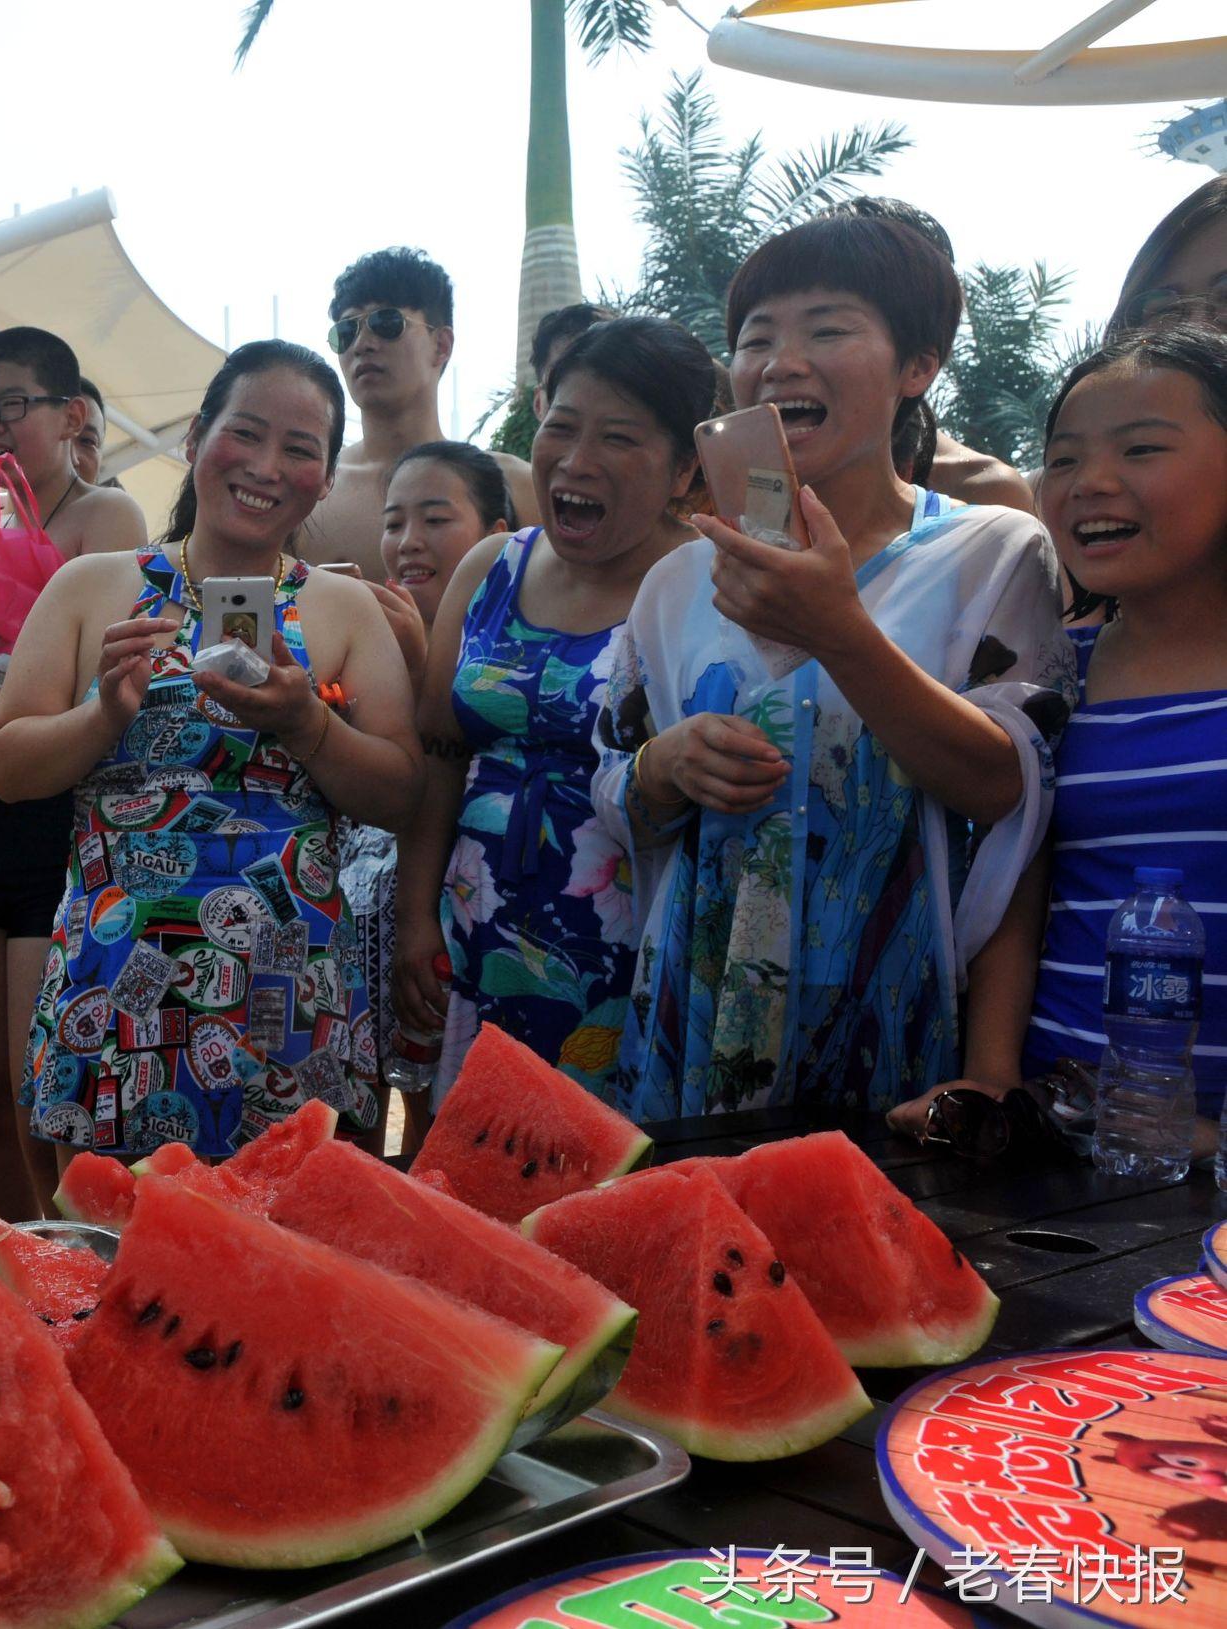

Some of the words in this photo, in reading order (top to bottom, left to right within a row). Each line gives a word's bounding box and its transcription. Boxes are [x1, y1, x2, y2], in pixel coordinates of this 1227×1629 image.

[125, 850, 191, 876] SIGAUT
[1128, 973, 1190, 1003] 冰露
[141, 1116, 195, 1141] SIGAUT
